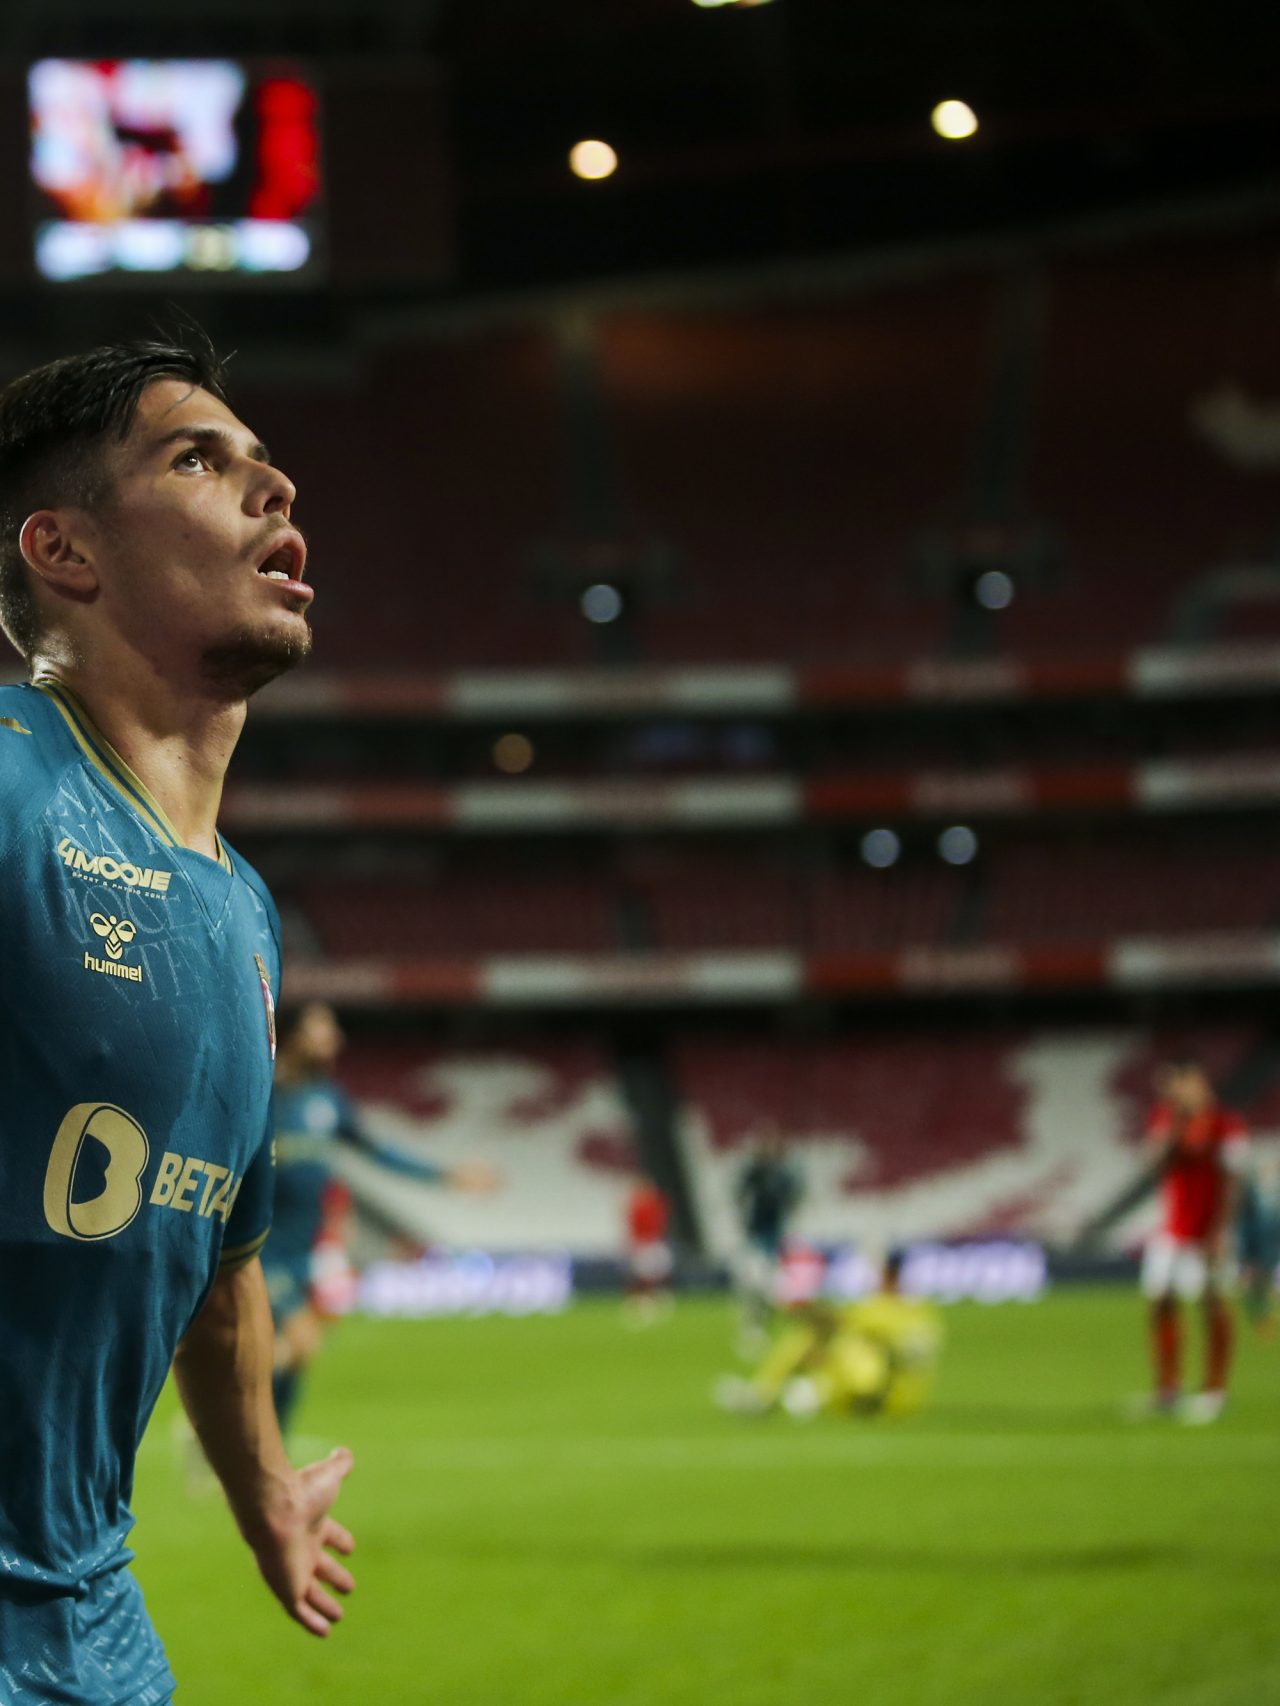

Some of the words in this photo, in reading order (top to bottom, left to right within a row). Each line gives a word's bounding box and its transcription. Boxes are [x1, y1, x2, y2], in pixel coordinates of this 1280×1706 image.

[72, 871, 99, 884] SPORT
[145, 890, 167, 901] ZONE
[83, 951, 143, 983] hummel
